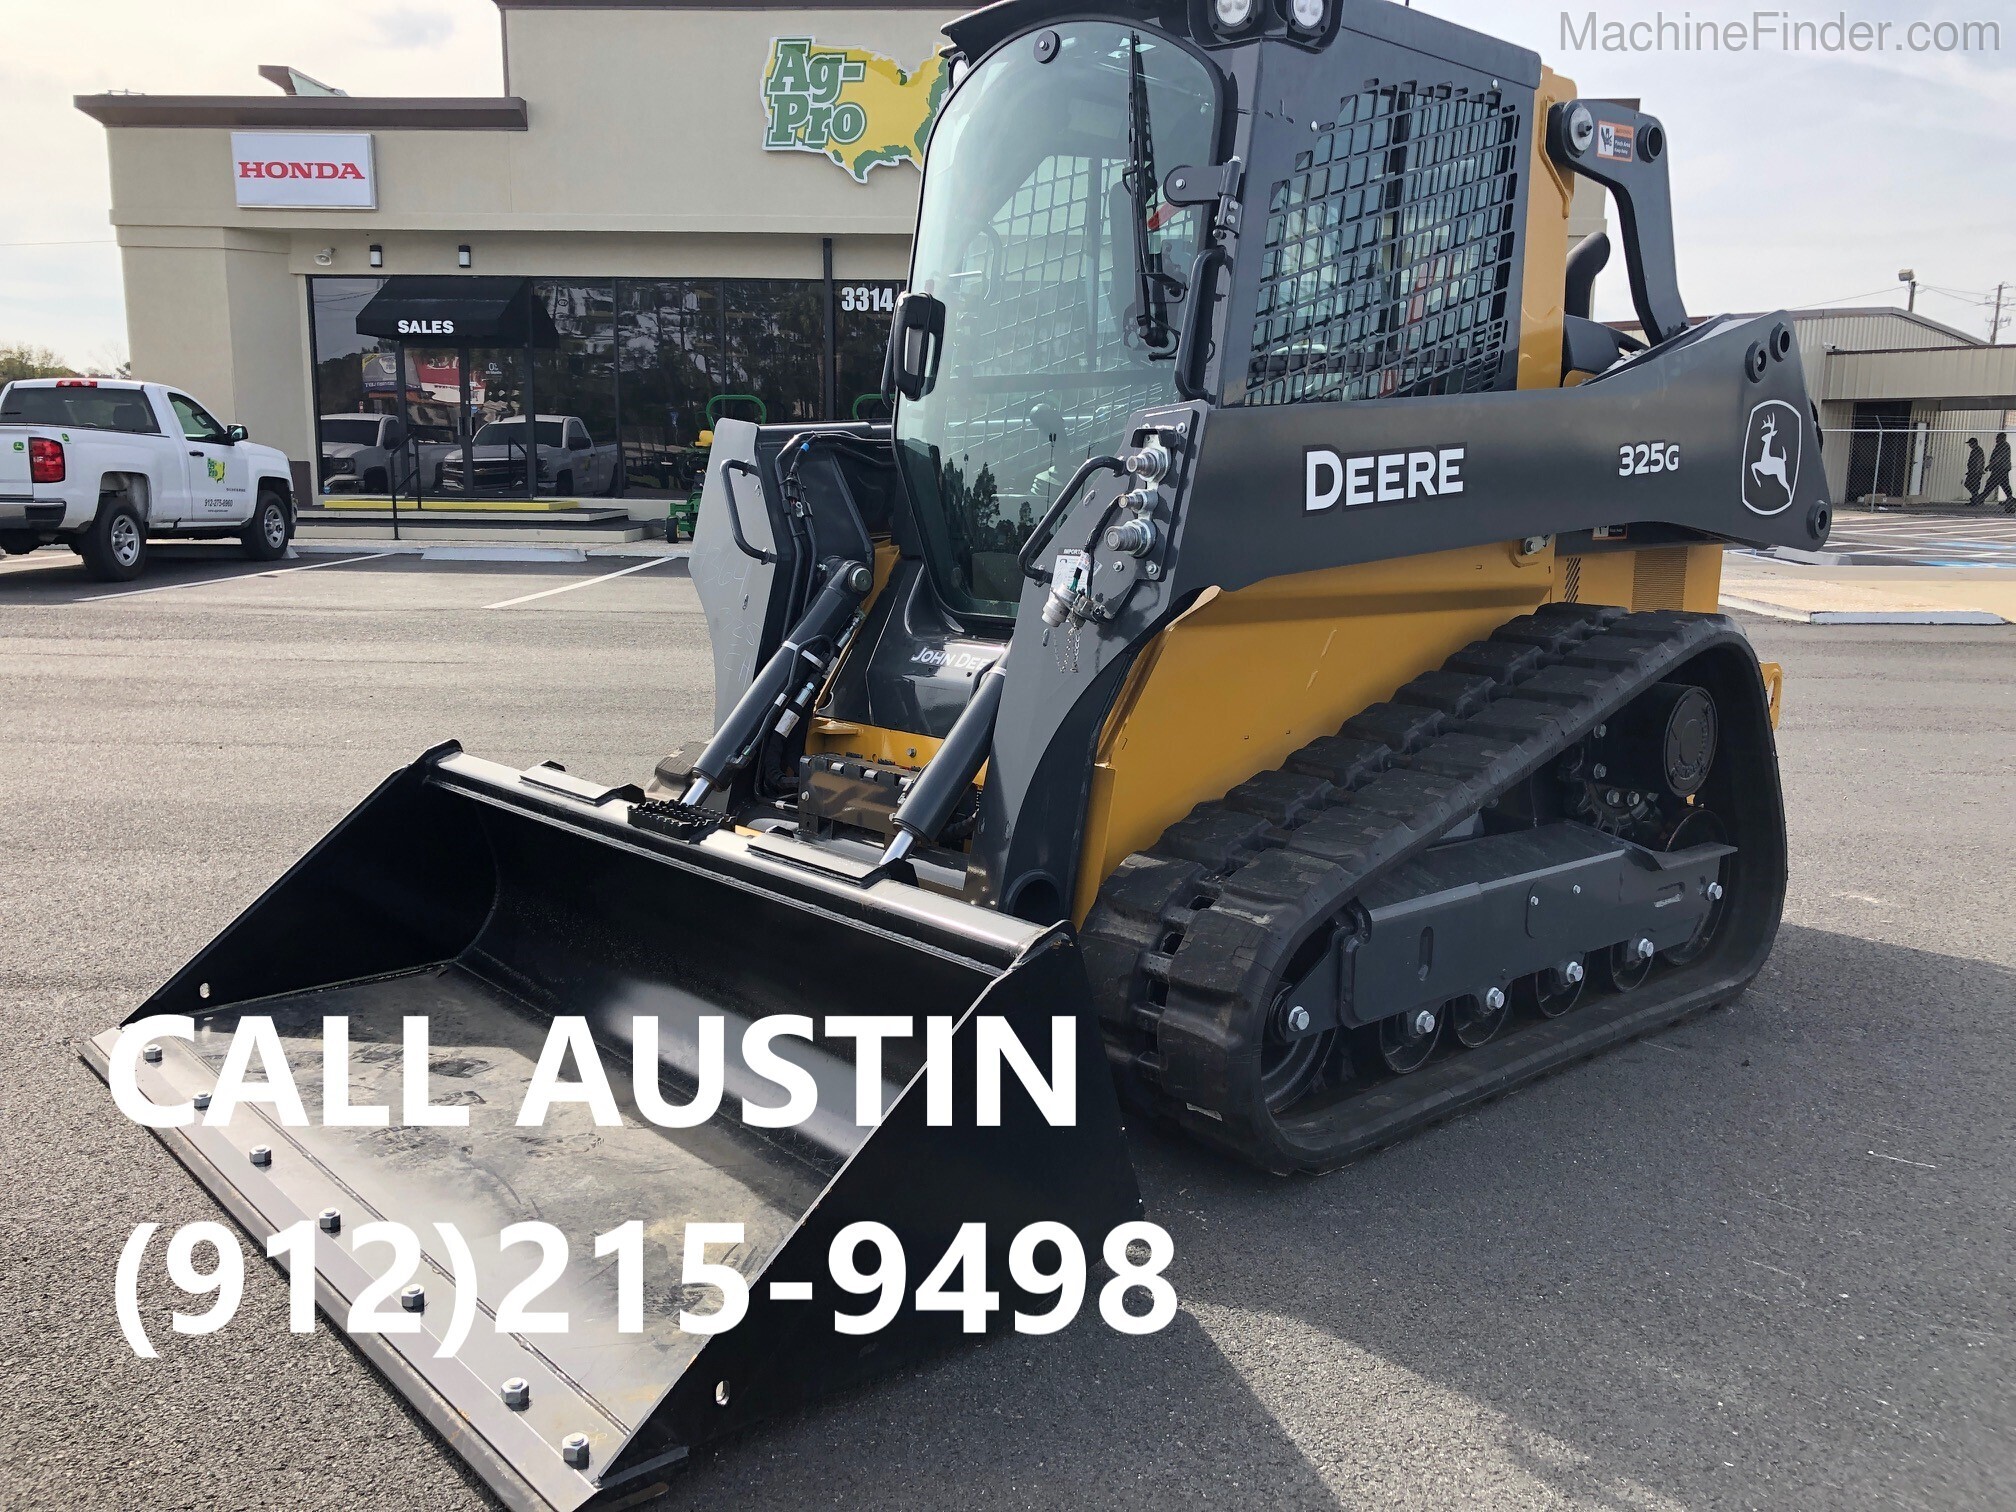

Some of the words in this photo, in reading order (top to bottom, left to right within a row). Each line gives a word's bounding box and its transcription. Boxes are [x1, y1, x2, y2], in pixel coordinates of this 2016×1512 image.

[765, 38, 866, 106] Ag-
[766, 92, 867, 147] Pro
[238, 161, 366, 179] HONDA
[841, 286, 895, 312] 3314
[397, 319, 455, 334] SALES
[1618, 442, 1680, 477] 325G
[1305, 447, 1465, 512] DEERE
[910, 647, 957, 667] JOHN
[954, 652, 992, 671] DEE
